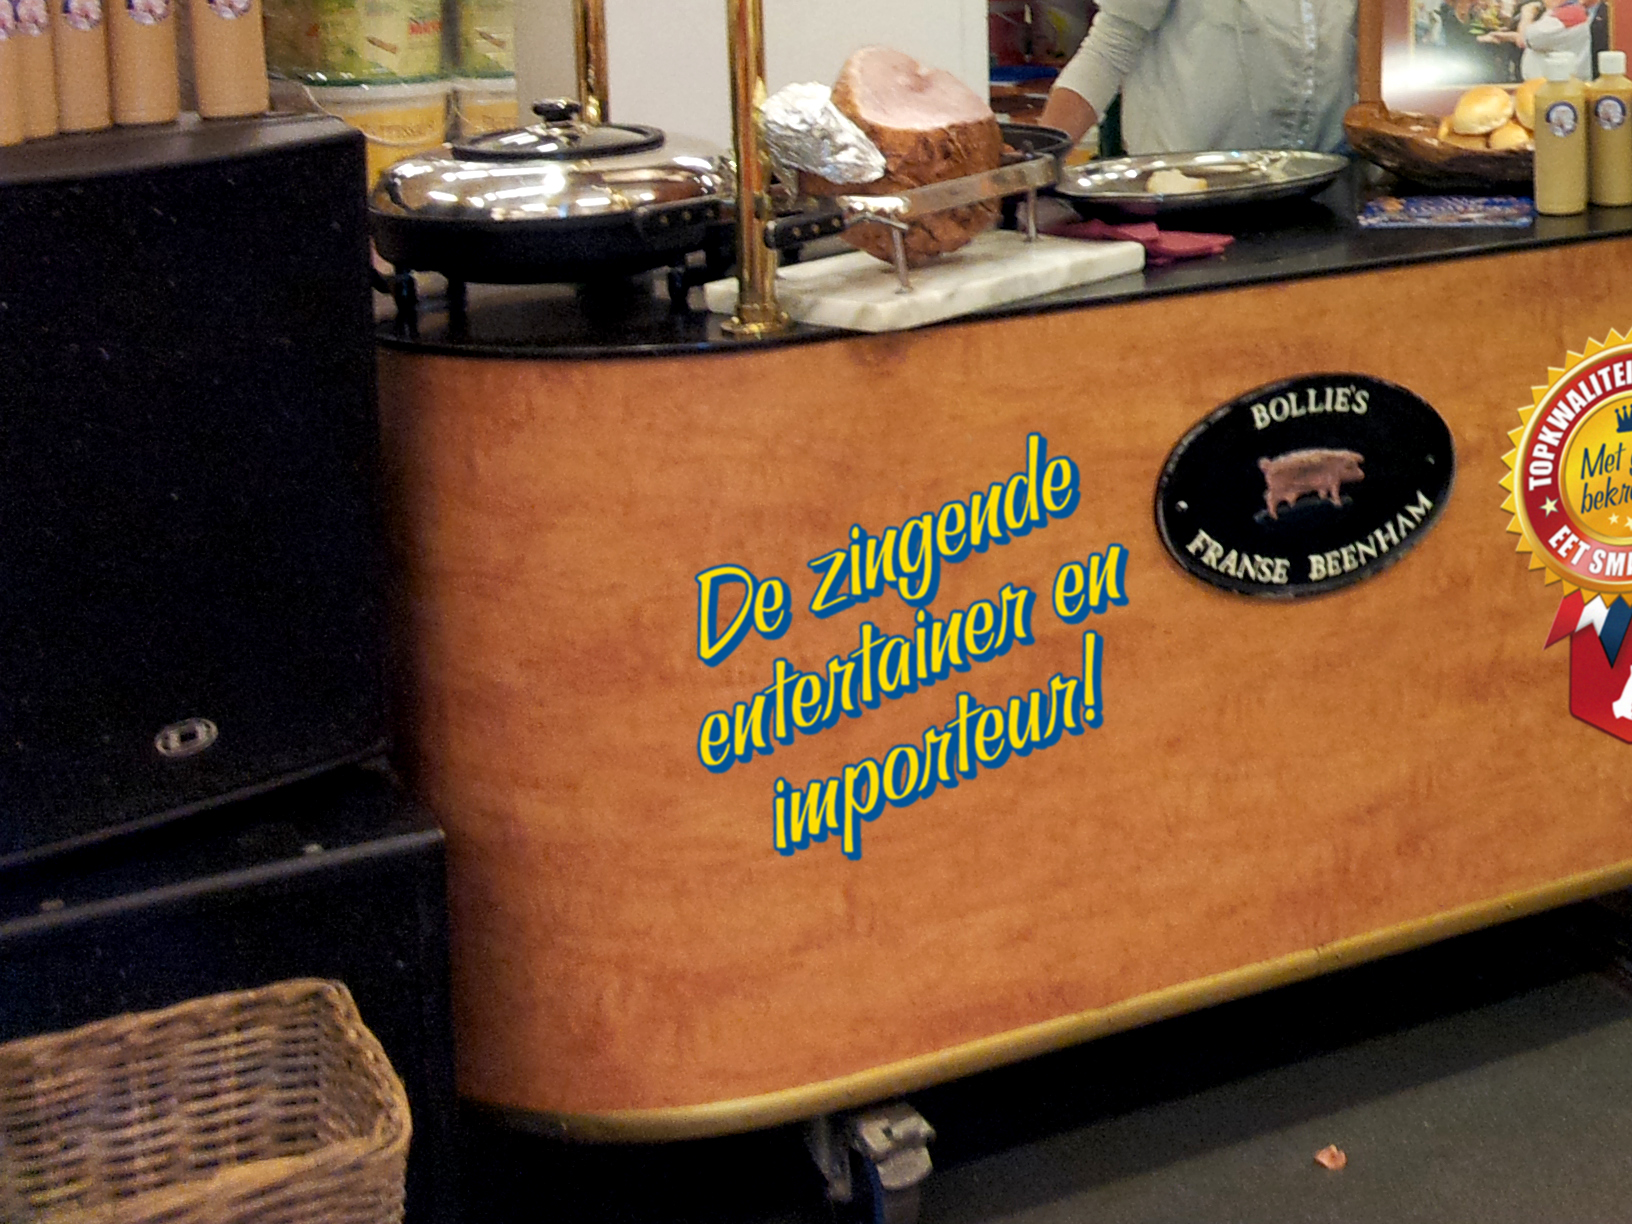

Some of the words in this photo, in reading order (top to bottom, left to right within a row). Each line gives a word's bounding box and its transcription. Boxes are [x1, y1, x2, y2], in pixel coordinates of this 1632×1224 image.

[1251, 384, 1370, 430] BOLLIE'S
[1580, 440, 1626, 480] Met
[696, 564, 791, 667] De
[808, 432, 1080, 607] zingende
[1186, 528, 1291, 585] FRANSE
[1307, 489, 1434, 582] BEENHAM
[1548, 524, 1591, 567] EET
[697, 584, 1036, 773] entertainer
[1052, 543, 1129, 624] en
[773, 630, 1104, 860] importeur!
